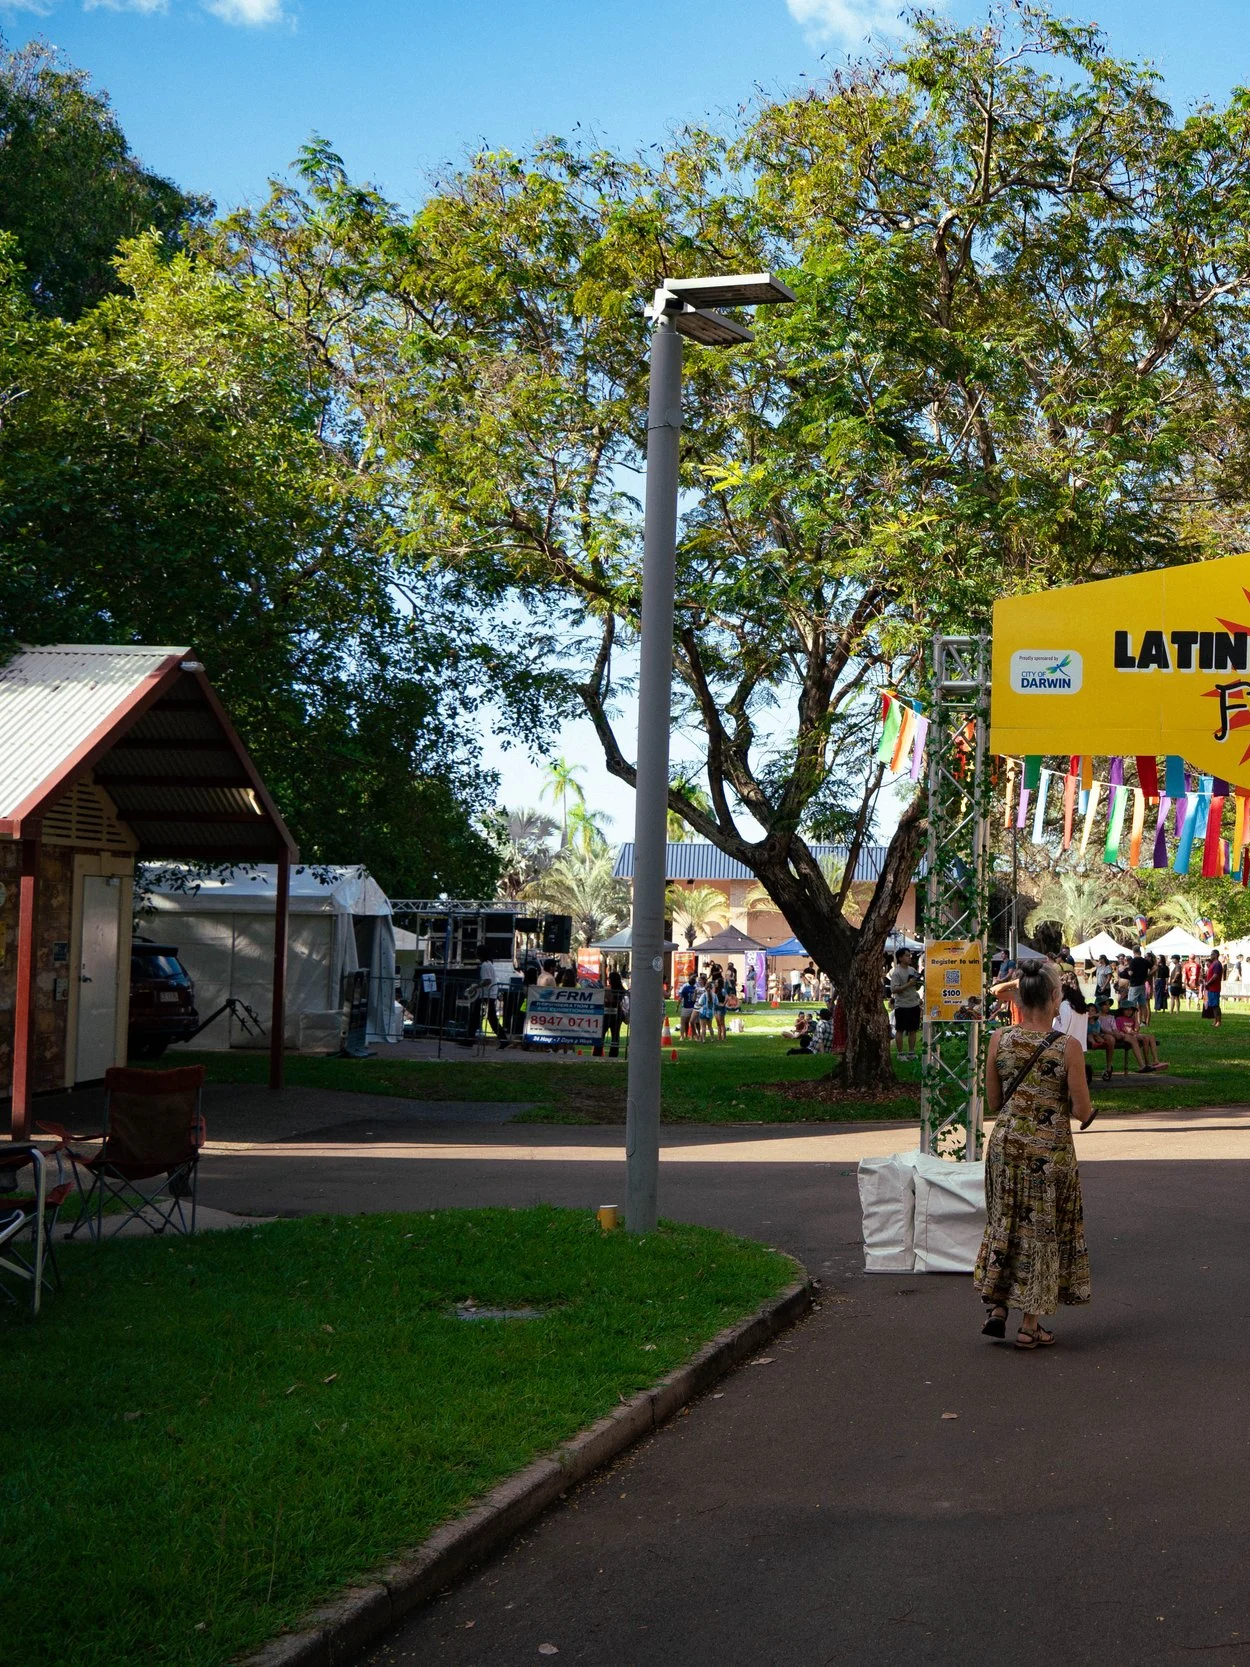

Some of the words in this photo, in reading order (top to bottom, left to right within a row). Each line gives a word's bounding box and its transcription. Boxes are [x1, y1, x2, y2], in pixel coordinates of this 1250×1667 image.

[1114, 630, 1250, 672] LATIN
[1021, 678, 1071, 688] DARWIN
[555, 991, 593, 1001] FRM
[530, 1016, 563, 1026] 8947
[568, 1018, 599, 1028] 0711
